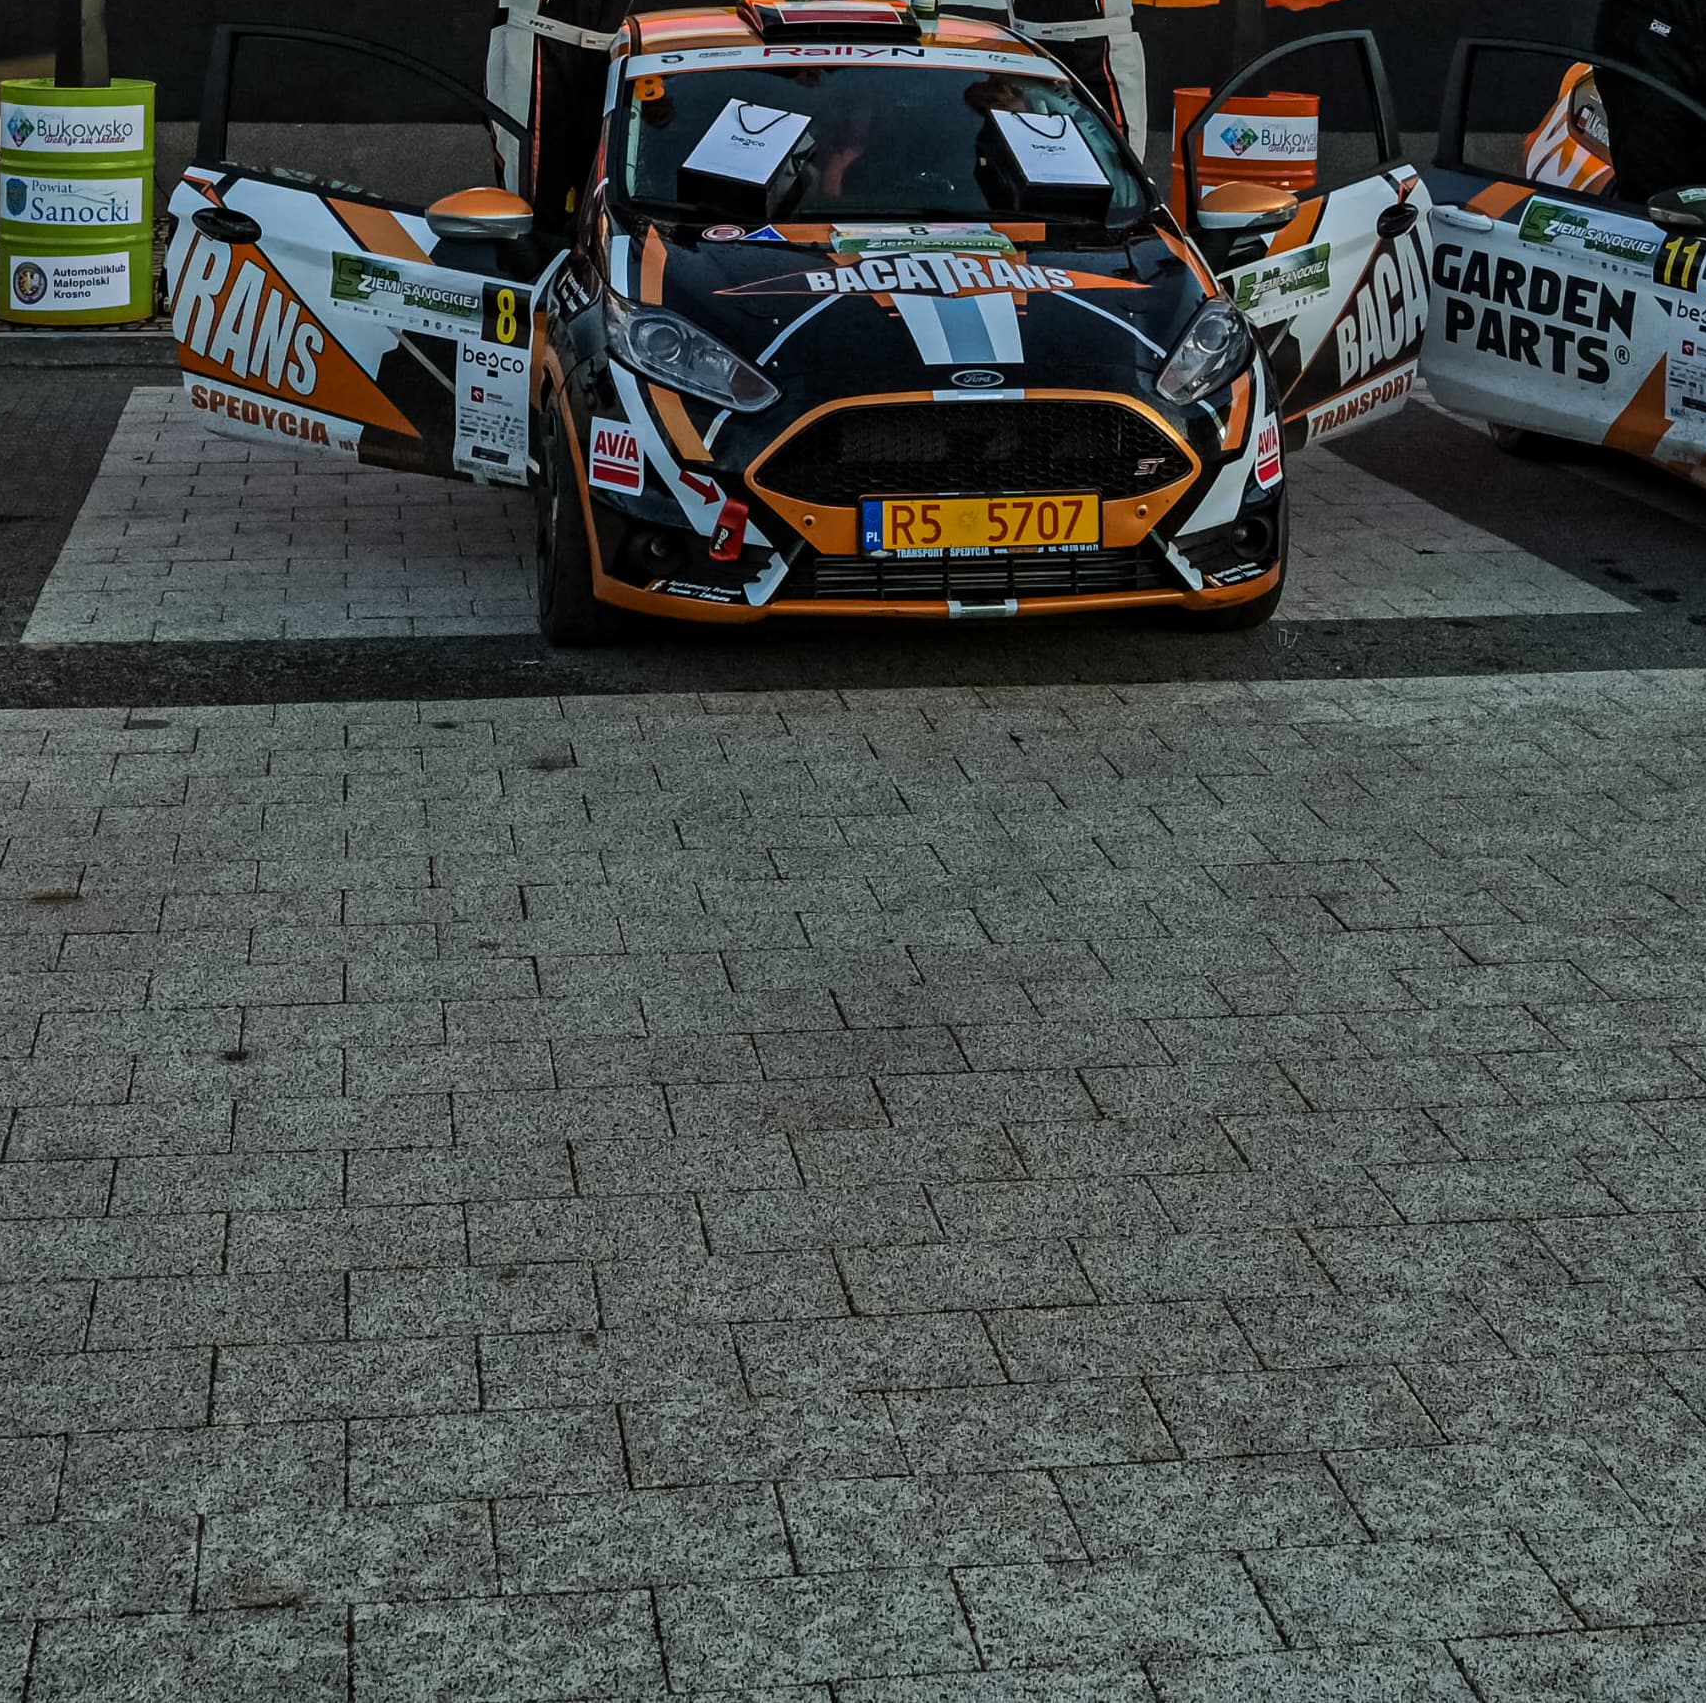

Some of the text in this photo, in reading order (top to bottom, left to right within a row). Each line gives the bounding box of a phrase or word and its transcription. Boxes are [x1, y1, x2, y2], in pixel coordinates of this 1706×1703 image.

[37, 118, 134, 139] Bukowsko
[31, 179, 73, 194] Powiat
[30, 196, 130, 223] Sanocki
[1544, 220, 1586, 240] ZIEMI
[1585, 228, 1658, 255] SANOCKIEJ
[52, 264, 126, 278] Automobilklub
[805, 252, 1075, 295] BACATRANS
[1665, 236, 1701, 289] 11
[53, 288, 91, 299] Krosno
[358, 274, 480, 310] ZIEMI SANOCKIEJ
[1431, 242, 1637, 342] GARDEN
[496, 288, 517, 345] 8
[1445, 297, 1611, 385] PARTS
[961, 372, 992, 385] Ford
[191, 384, 331, 447] SPEDYCJA
[1311, 368, 1414, 438] TRANSPORT
[1134, 458, 1166, 476] ST
[866, 531, 881, 543] PL
[892, 500, 1084, 545] R5 5707
[896, 548, 944, 559] TRANSPORT
[949, 546, 990, 557] SPEDYCJA
